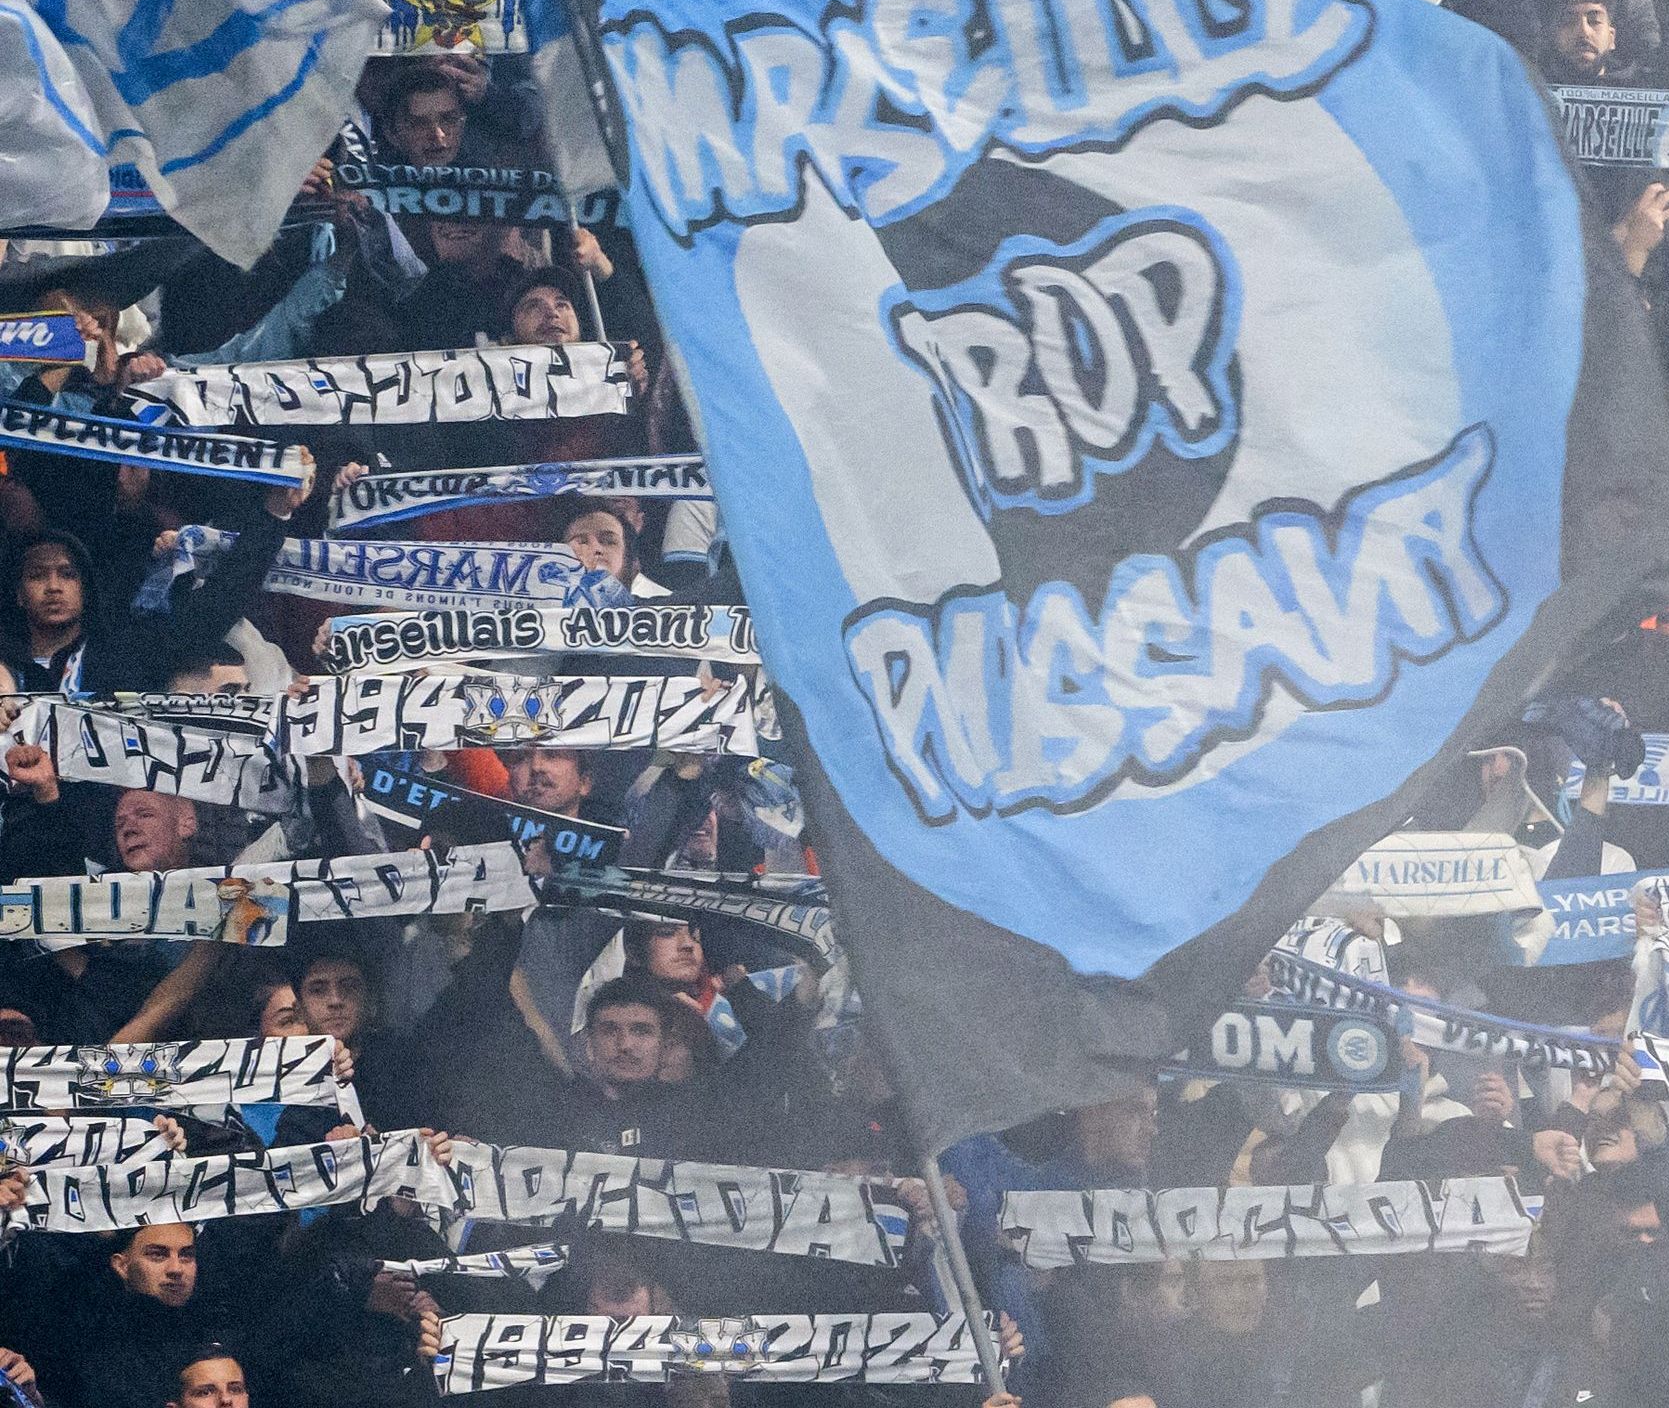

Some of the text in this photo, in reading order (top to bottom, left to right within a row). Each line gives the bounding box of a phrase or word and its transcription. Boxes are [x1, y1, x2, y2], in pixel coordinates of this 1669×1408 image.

[2, 407, 288, 470] EPLACEMENT
[564, 604, 711, 651] Avant
[291, 676, 464, 753] 994
[1356, 856, 1509, 886] MARSEILLE
[1210, 1010, 1316, 1076] OM
